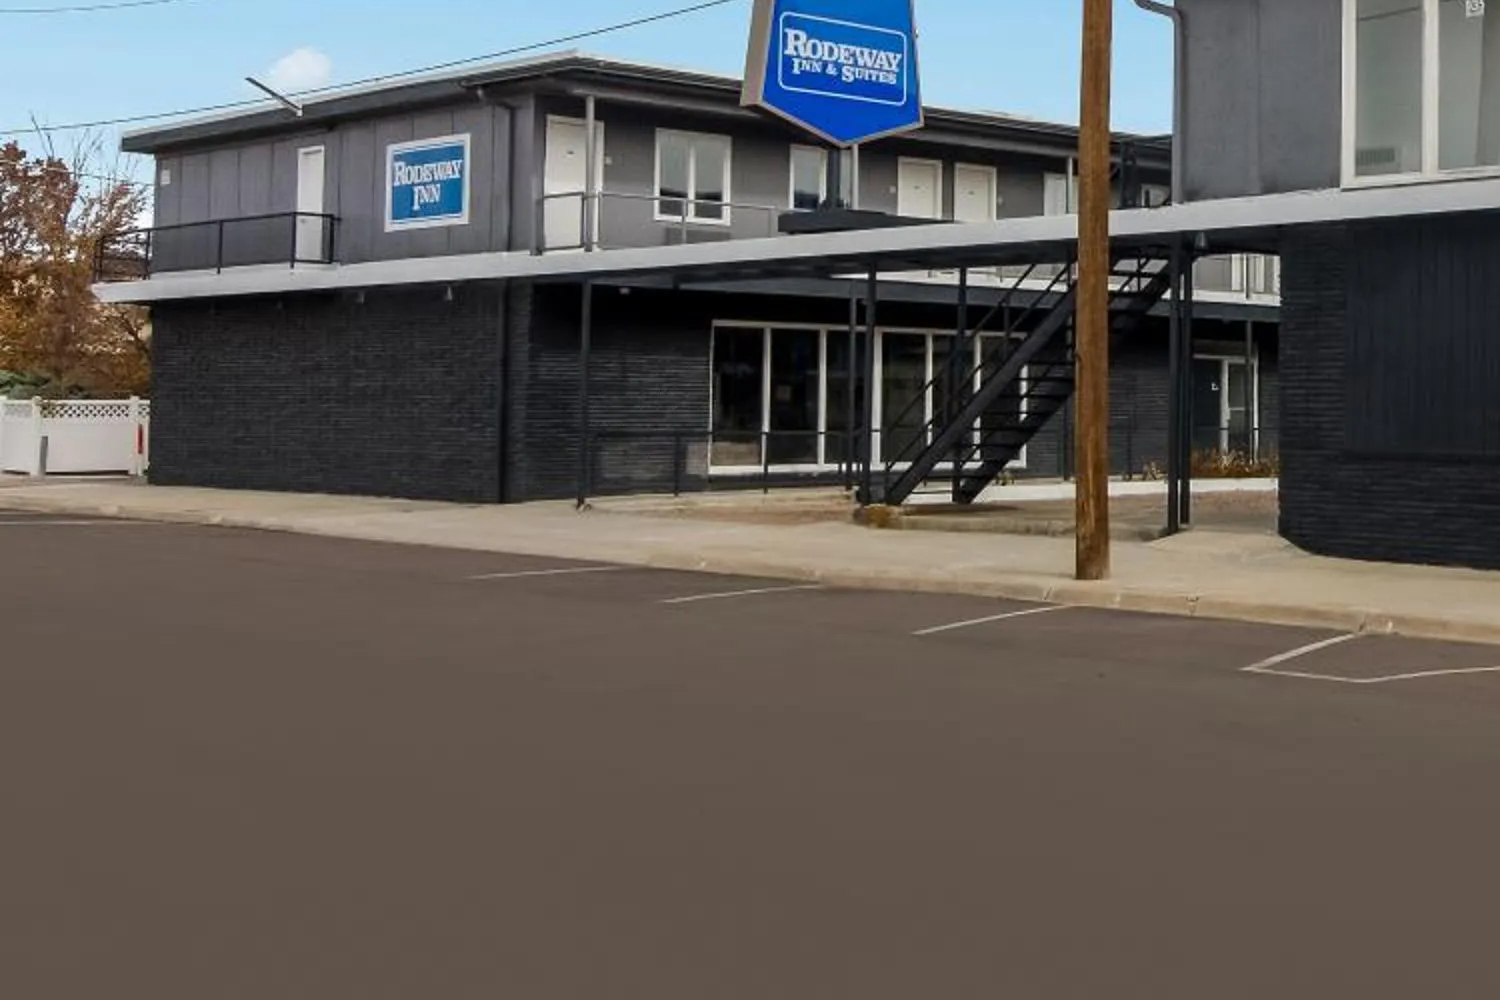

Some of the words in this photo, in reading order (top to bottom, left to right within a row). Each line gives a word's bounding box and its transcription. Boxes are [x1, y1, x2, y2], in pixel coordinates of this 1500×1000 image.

[784, 28, 902, 72] RODEWAY
[792, 57, 822, 74] INN
[826, 63, 838, 76] &
[842, 65, 897, 85] SUITES
[412, 184, 441, 211] INN
